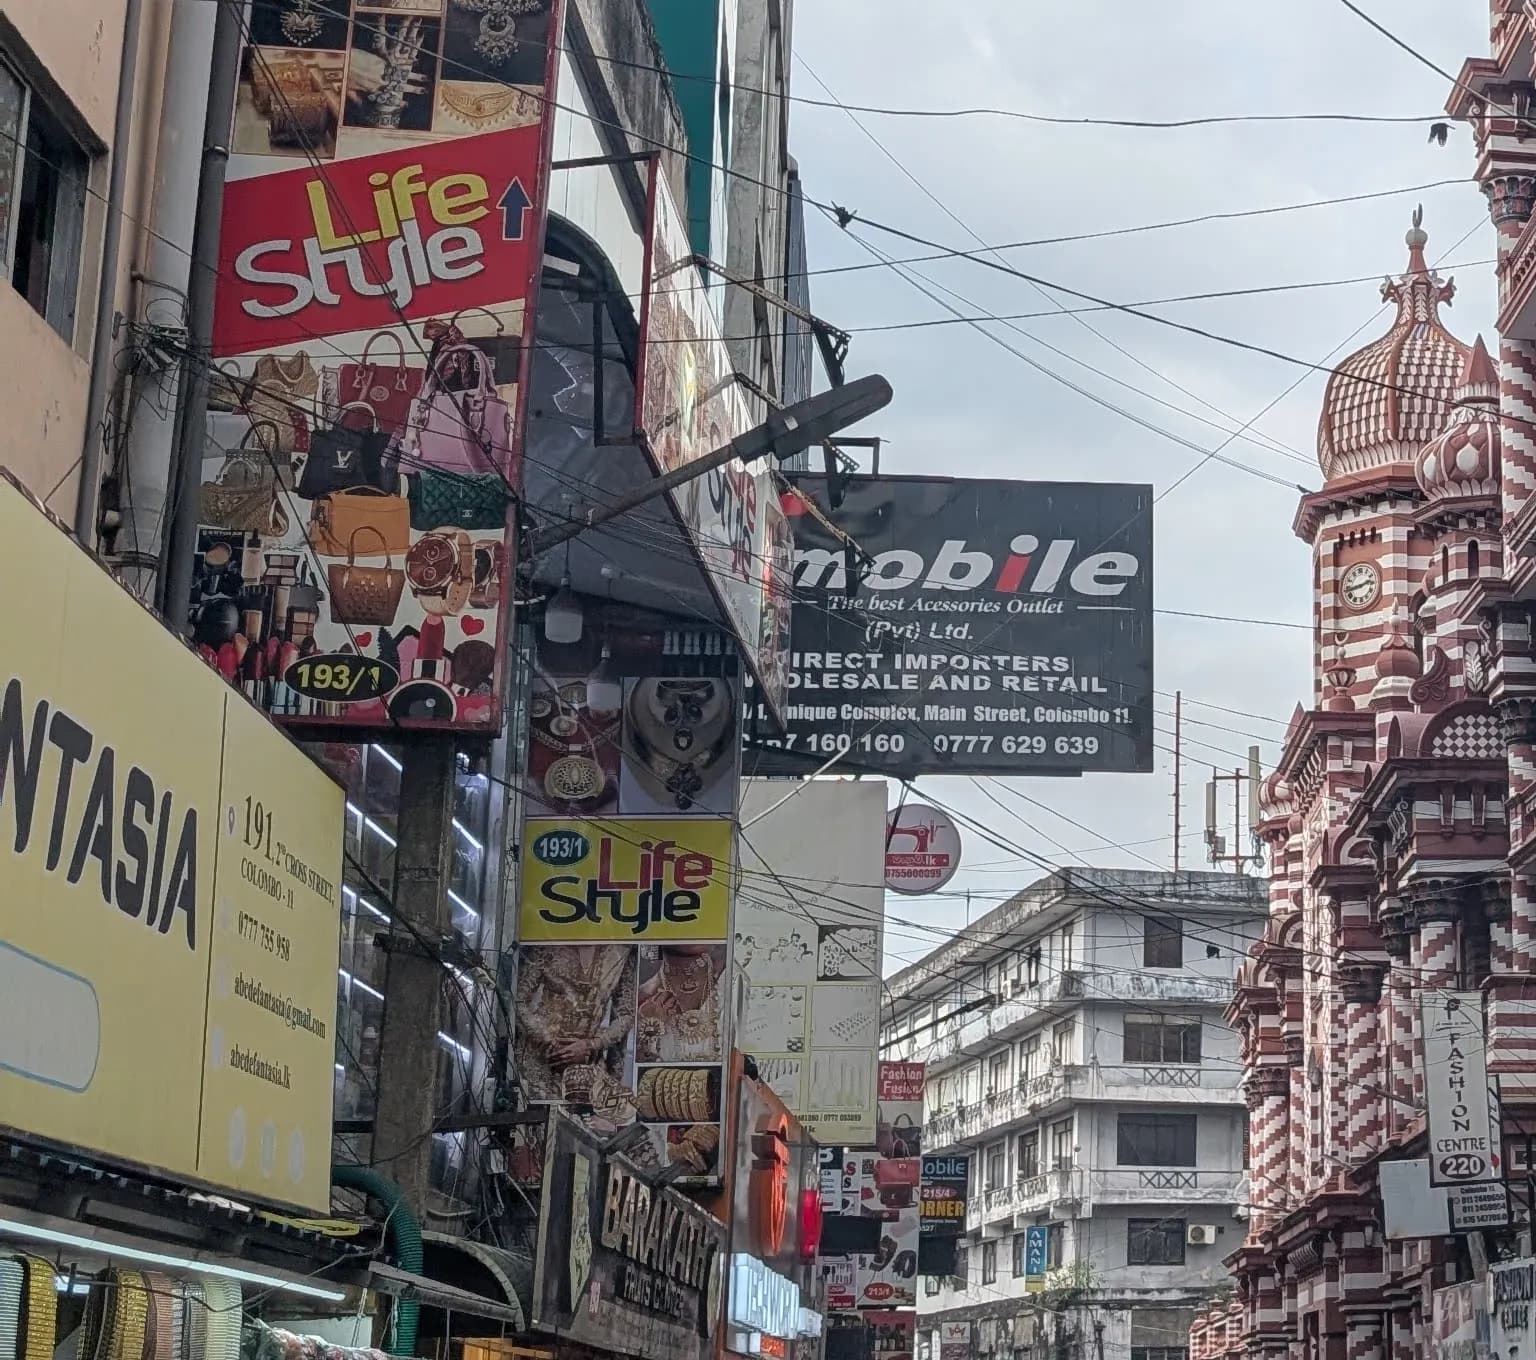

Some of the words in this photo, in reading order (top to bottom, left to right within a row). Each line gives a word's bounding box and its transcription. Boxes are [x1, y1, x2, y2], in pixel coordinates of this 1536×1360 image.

[305, 165, 489, 252] Life
[235, 224, 487, 319] Style
[795, 534, 1139, 596] mobile
[828, 595, 864, 611] The
[867, 594, 904, 612] best
[908, 597, 1001, 614] Acessories
[1006, 599, 1065, 615] Outlet
[865, 620, 921, 642] (Pvt)
[929, 623, 974, 641] Ltd.
[792, 652, 883, 670] IRECT
[894, 653, 1070, 672] IMPORTERS
[295, 662, 382, 693] 193/1
[928, 675, 991, 691] AND
[1002, 675, 1108, 693] RETAIL
[786, 703, 838, 722] nique
[840, 703, 921, 723] Complex,
[924, 704, 967, 722] Main
[973, 705, 1030, 724] Street,
[1033, 706, 1109, 723] Colombo
[806, 734, 852, 753] 160
[857, 734, 905, 754] 160
[933, 735, 993, 755] 0777
[1001, 735, 1047, 755] 629
[1054, 735, 1099, 755] 639
[539, 837, 582, 858] 193/1
[285, 851, 308, 886] CROSS
[599, 837, 713, 890] Life
[241, 857, 282, 902] COLOMBO
[539, 875, 701, 935] Style
[238, 910, 258, 944] 0777
[881, 1065, 922, 1080] Fashion
[1448, 1032, 1471, 1132] FASHION
[883, 1080, 919, 1094] Fusion
[1437, 1136, 1487, 1153] CENTRE
[1444, 1157, 1481, 1176] 220
[919, 1200, 965, 1217] ORNER
